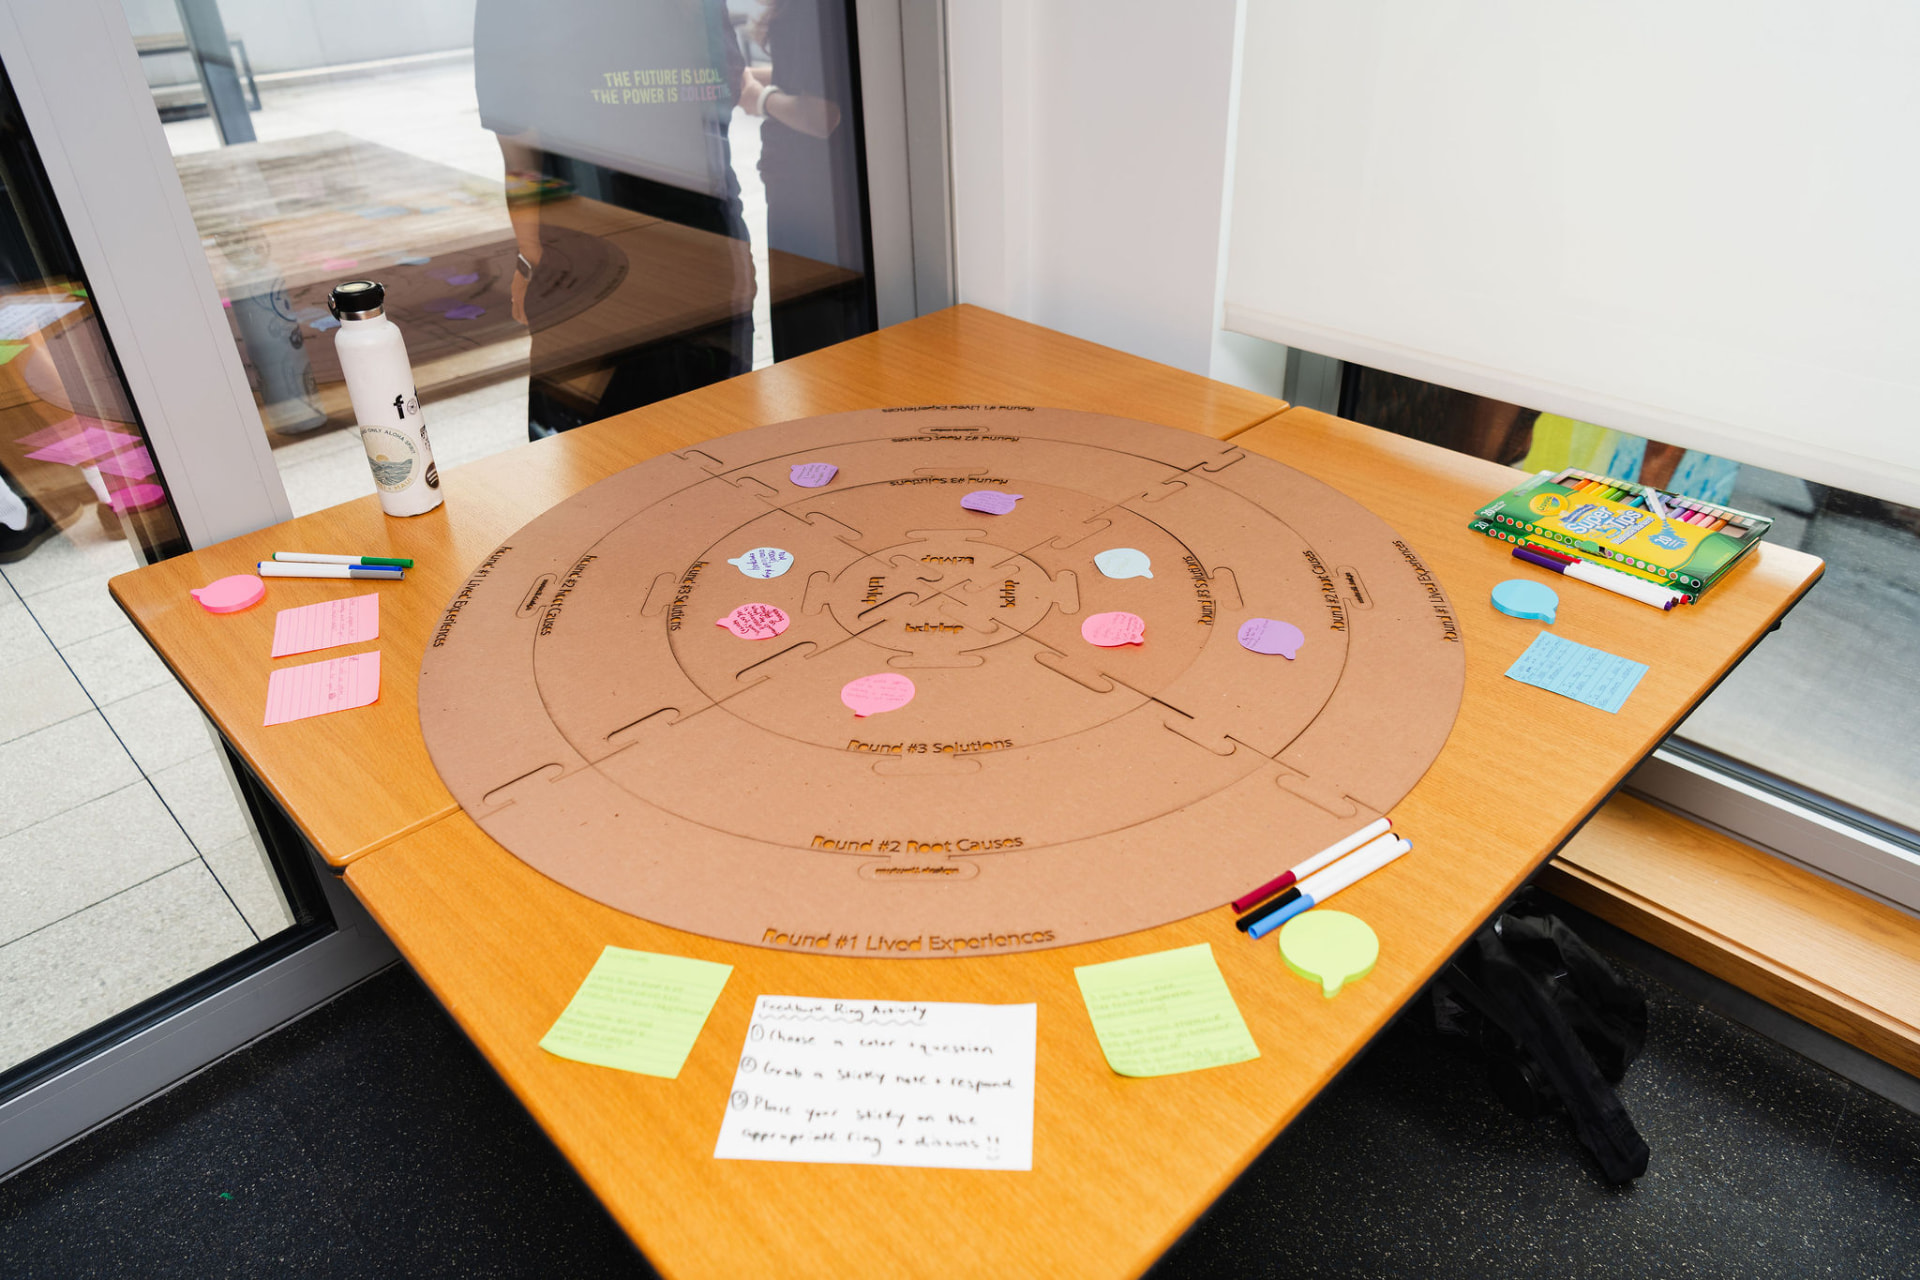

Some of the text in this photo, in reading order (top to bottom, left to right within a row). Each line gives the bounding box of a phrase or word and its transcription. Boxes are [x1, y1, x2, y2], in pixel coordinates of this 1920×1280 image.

[603, 68, 722, 87] THE FUTURE IS LOCAL
[590, 84, 731, 104] THE POWER IS COLLECT
[385, 430, 404, 441] ALOHA
[889, 476, 947, 487] Solutions
[968, 477, 1009, 486] Round
[1474, 520, 1489, 530] 20
[1564, 505, 1614, 534] Super
[1605, 509, 1643, 530] Tips
[482, 546, 513, 569] Round
[568, 554, 599, 578] Round
[458, 579, 484, 600] Lived
[670, 561, 710, 632] Round #3 Solutions
[540, 608, 562, 636] Causes
[1197, 600, 1213, 626] Round
[1326, 605, 1345, 632] Round
[433, 600, 468, 648] Experiences
[1436, 615, 1459, 642] Round
[846, 737, 1014, 754] Round #3 Solutions
[810, 834, 1024, 854] Round #2 Root Causes
[761, 928, 1056, 954] Round #1 Lived Experiences
[834, 1003, 864, 1022] Ring
[769, 1029, 816, 1045] Choose
[951, 1077, 1014, 1094] respond
[948, 1114, 976, 1124] the
